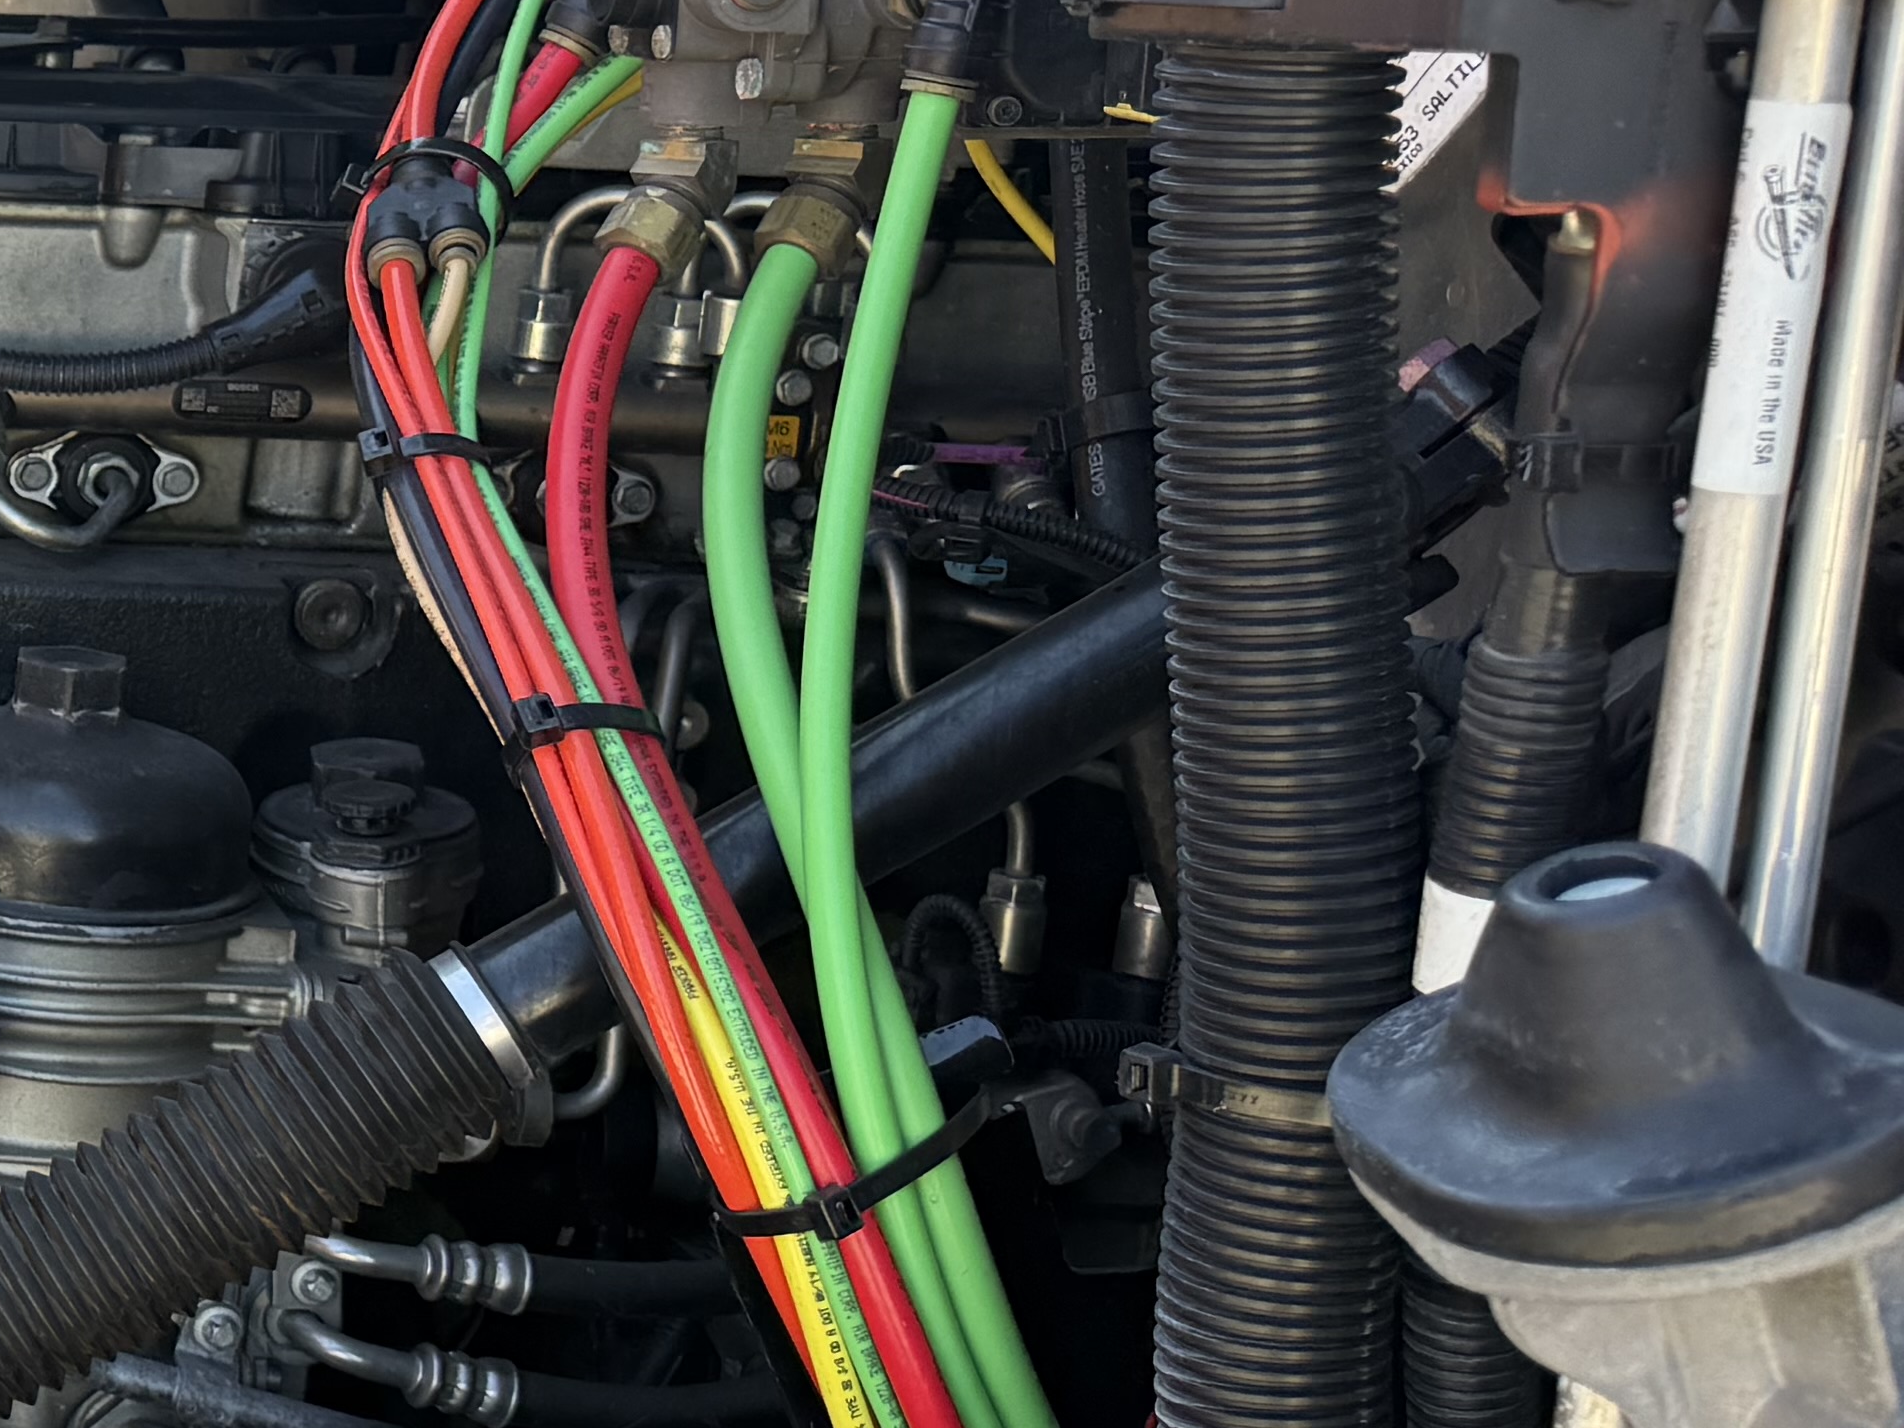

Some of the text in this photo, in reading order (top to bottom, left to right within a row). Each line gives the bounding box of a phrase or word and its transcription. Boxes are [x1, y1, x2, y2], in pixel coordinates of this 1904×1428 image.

[1081, 341, 1096, 374] Blue
[1758, 397, 1782, 424] the
[1752, 430, 1777, 465] USA
[1087, 443, 1105, 496] GATES
[619, 775, 643, 800] TYPE
[665, 869, 688, 888] DOT
[726, 1008, 758, 1061] EXTRUDED
[743, 1097, 758, 1116] THE
[761, 1140, 789, 1190] EXTRUDED
[844, 1395, 864, 1420] TYPE
